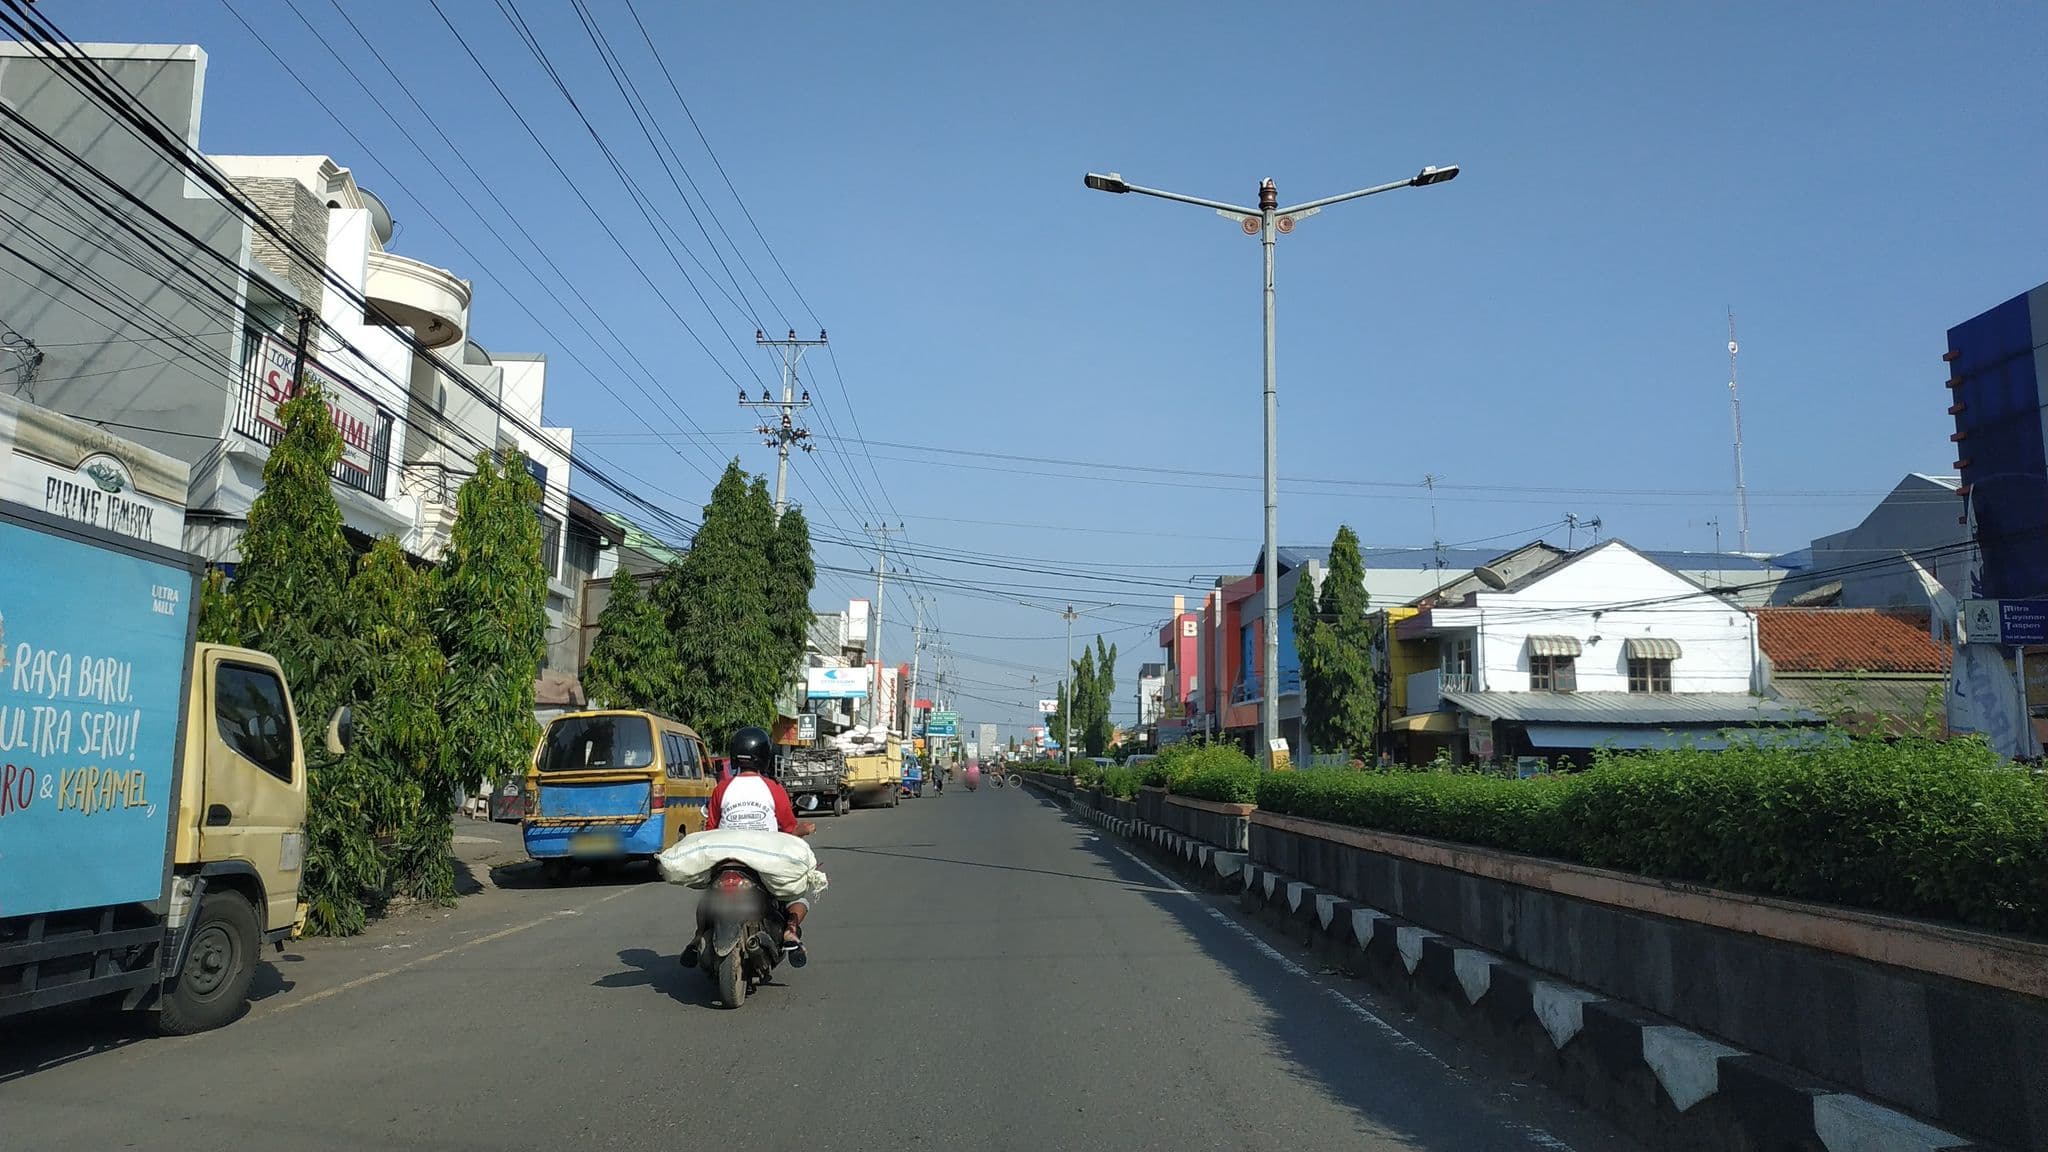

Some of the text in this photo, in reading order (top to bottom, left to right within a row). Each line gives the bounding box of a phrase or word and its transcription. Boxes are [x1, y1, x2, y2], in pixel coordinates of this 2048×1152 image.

[46, 476, 101, 527] PIRING
[151, 584, 179, 602] ULTRA
[152, 599, 176, 616] MILK
[2003, 604, 2029, 614] Mitra
[2004, 613, 2046, 621] Layanan
[2005, 622, 2041, 630] Taspen
[13, 642, 71, 699] RASA
[0, 705, 141, 761] ULTRA SERU!
[39, 774, 53, 799] &
[57, 766, 149, 816] KARAMEL
